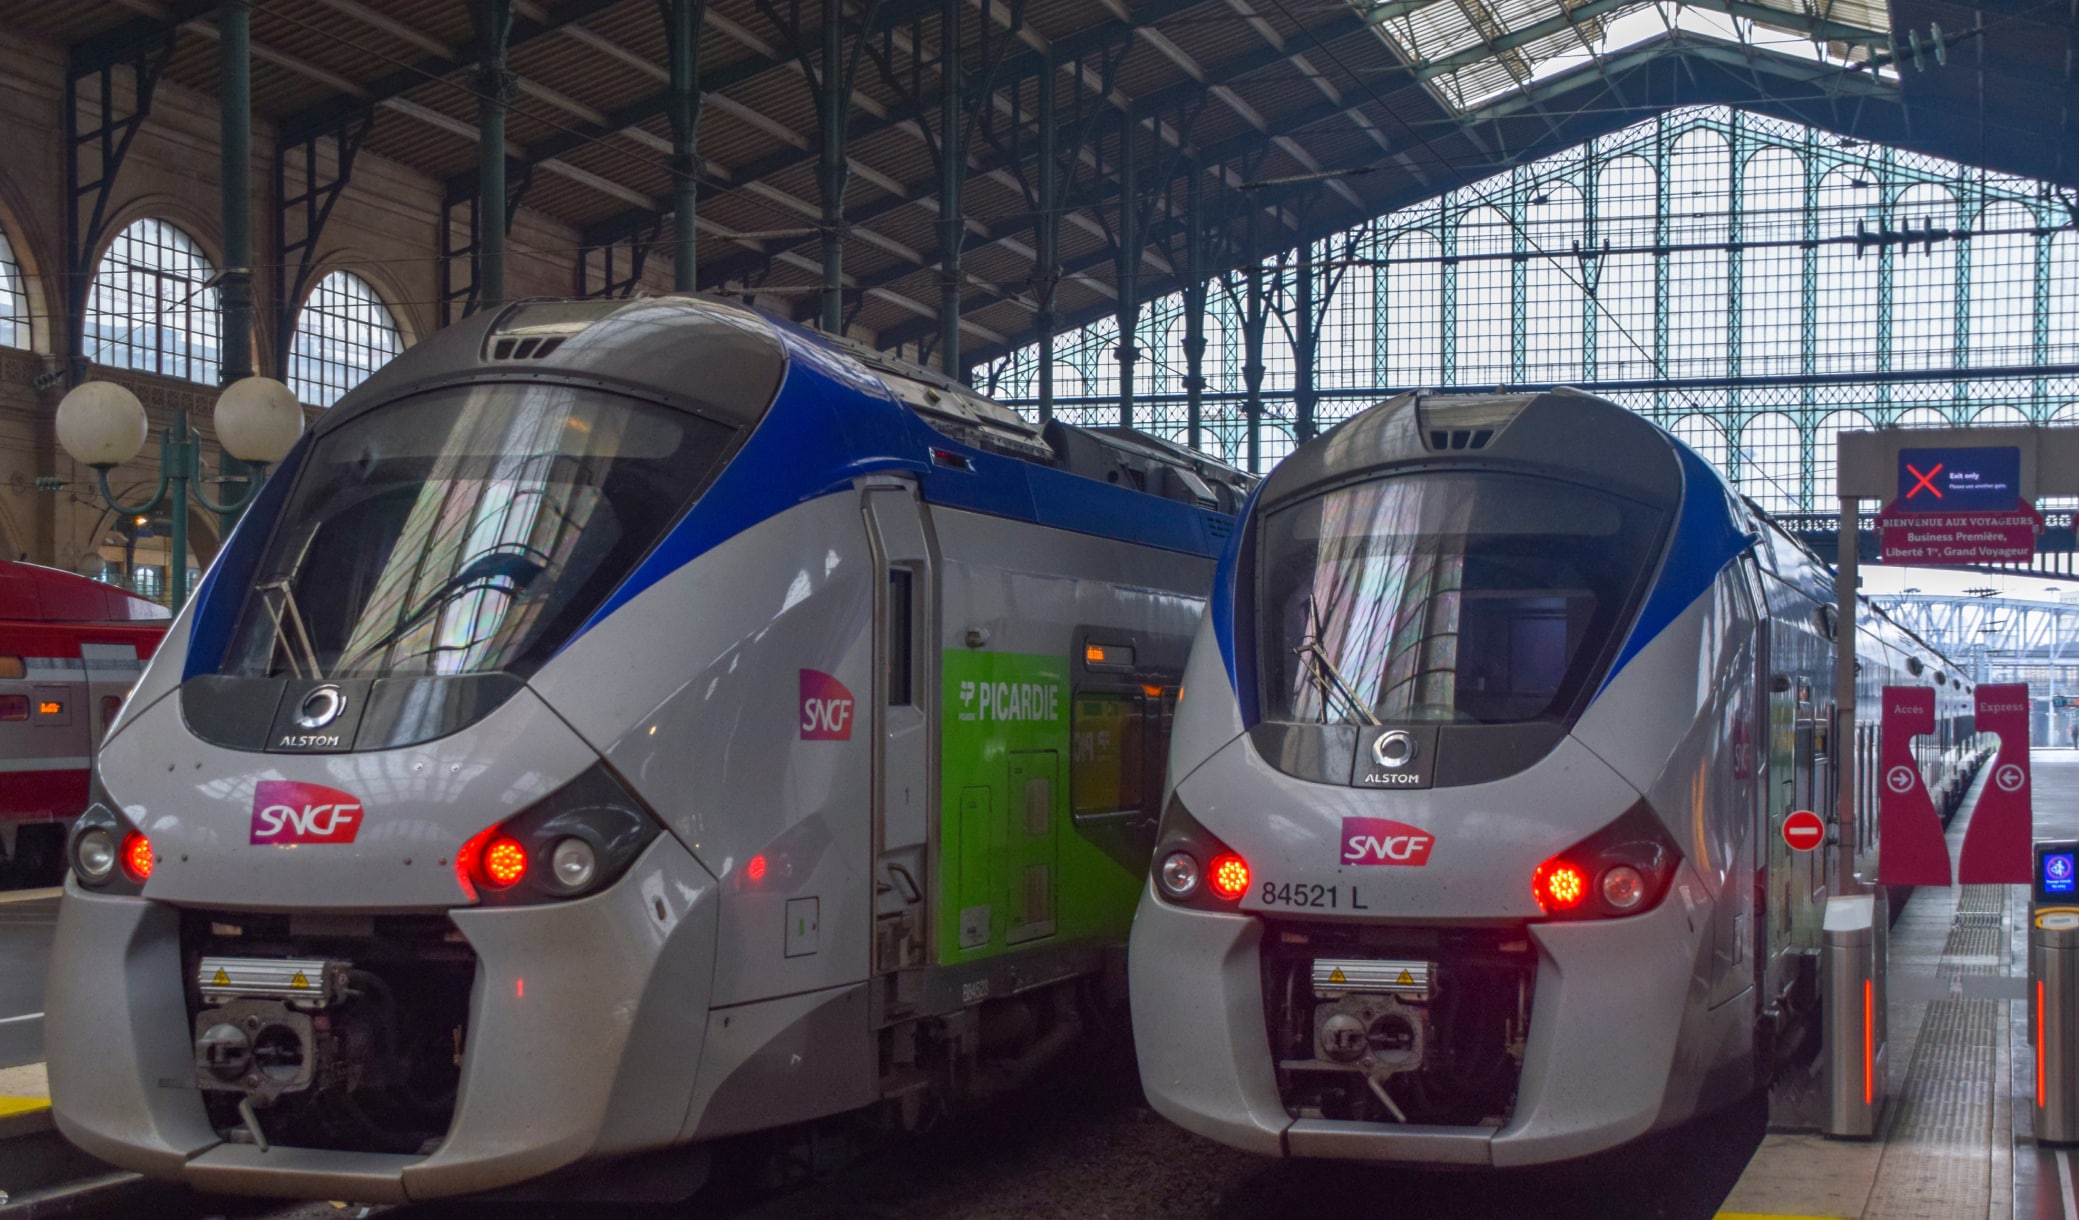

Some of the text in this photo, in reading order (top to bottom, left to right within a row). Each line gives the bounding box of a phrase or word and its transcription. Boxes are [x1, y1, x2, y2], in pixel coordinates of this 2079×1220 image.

[1883, 517, 2034, 527] BIENVENUE AUX VOYAGEURS
[1907, 531, 2007, 542] Business Première,
[1886, 547, 1924, 557] Liberté
[1944, 546, 1976, 556] Grand
[1978, 545, 2029, 558] Voyageur
[979, 681, 1058, 721] PICARDIE
[1980, 702, 2024, 712] Express
[802, 698, 850, 732] SNCF
[1894, 704, 1924, 714] Accès
[280, 735, 339, 747] ALSTOM
[1364, 773, 1419, 784] ALSTOM
[255, 804, 361, 836] SNCF
[1344, 835, 1428, 860] SNCF
[1261, 881, 1368, 909] 84521 L
